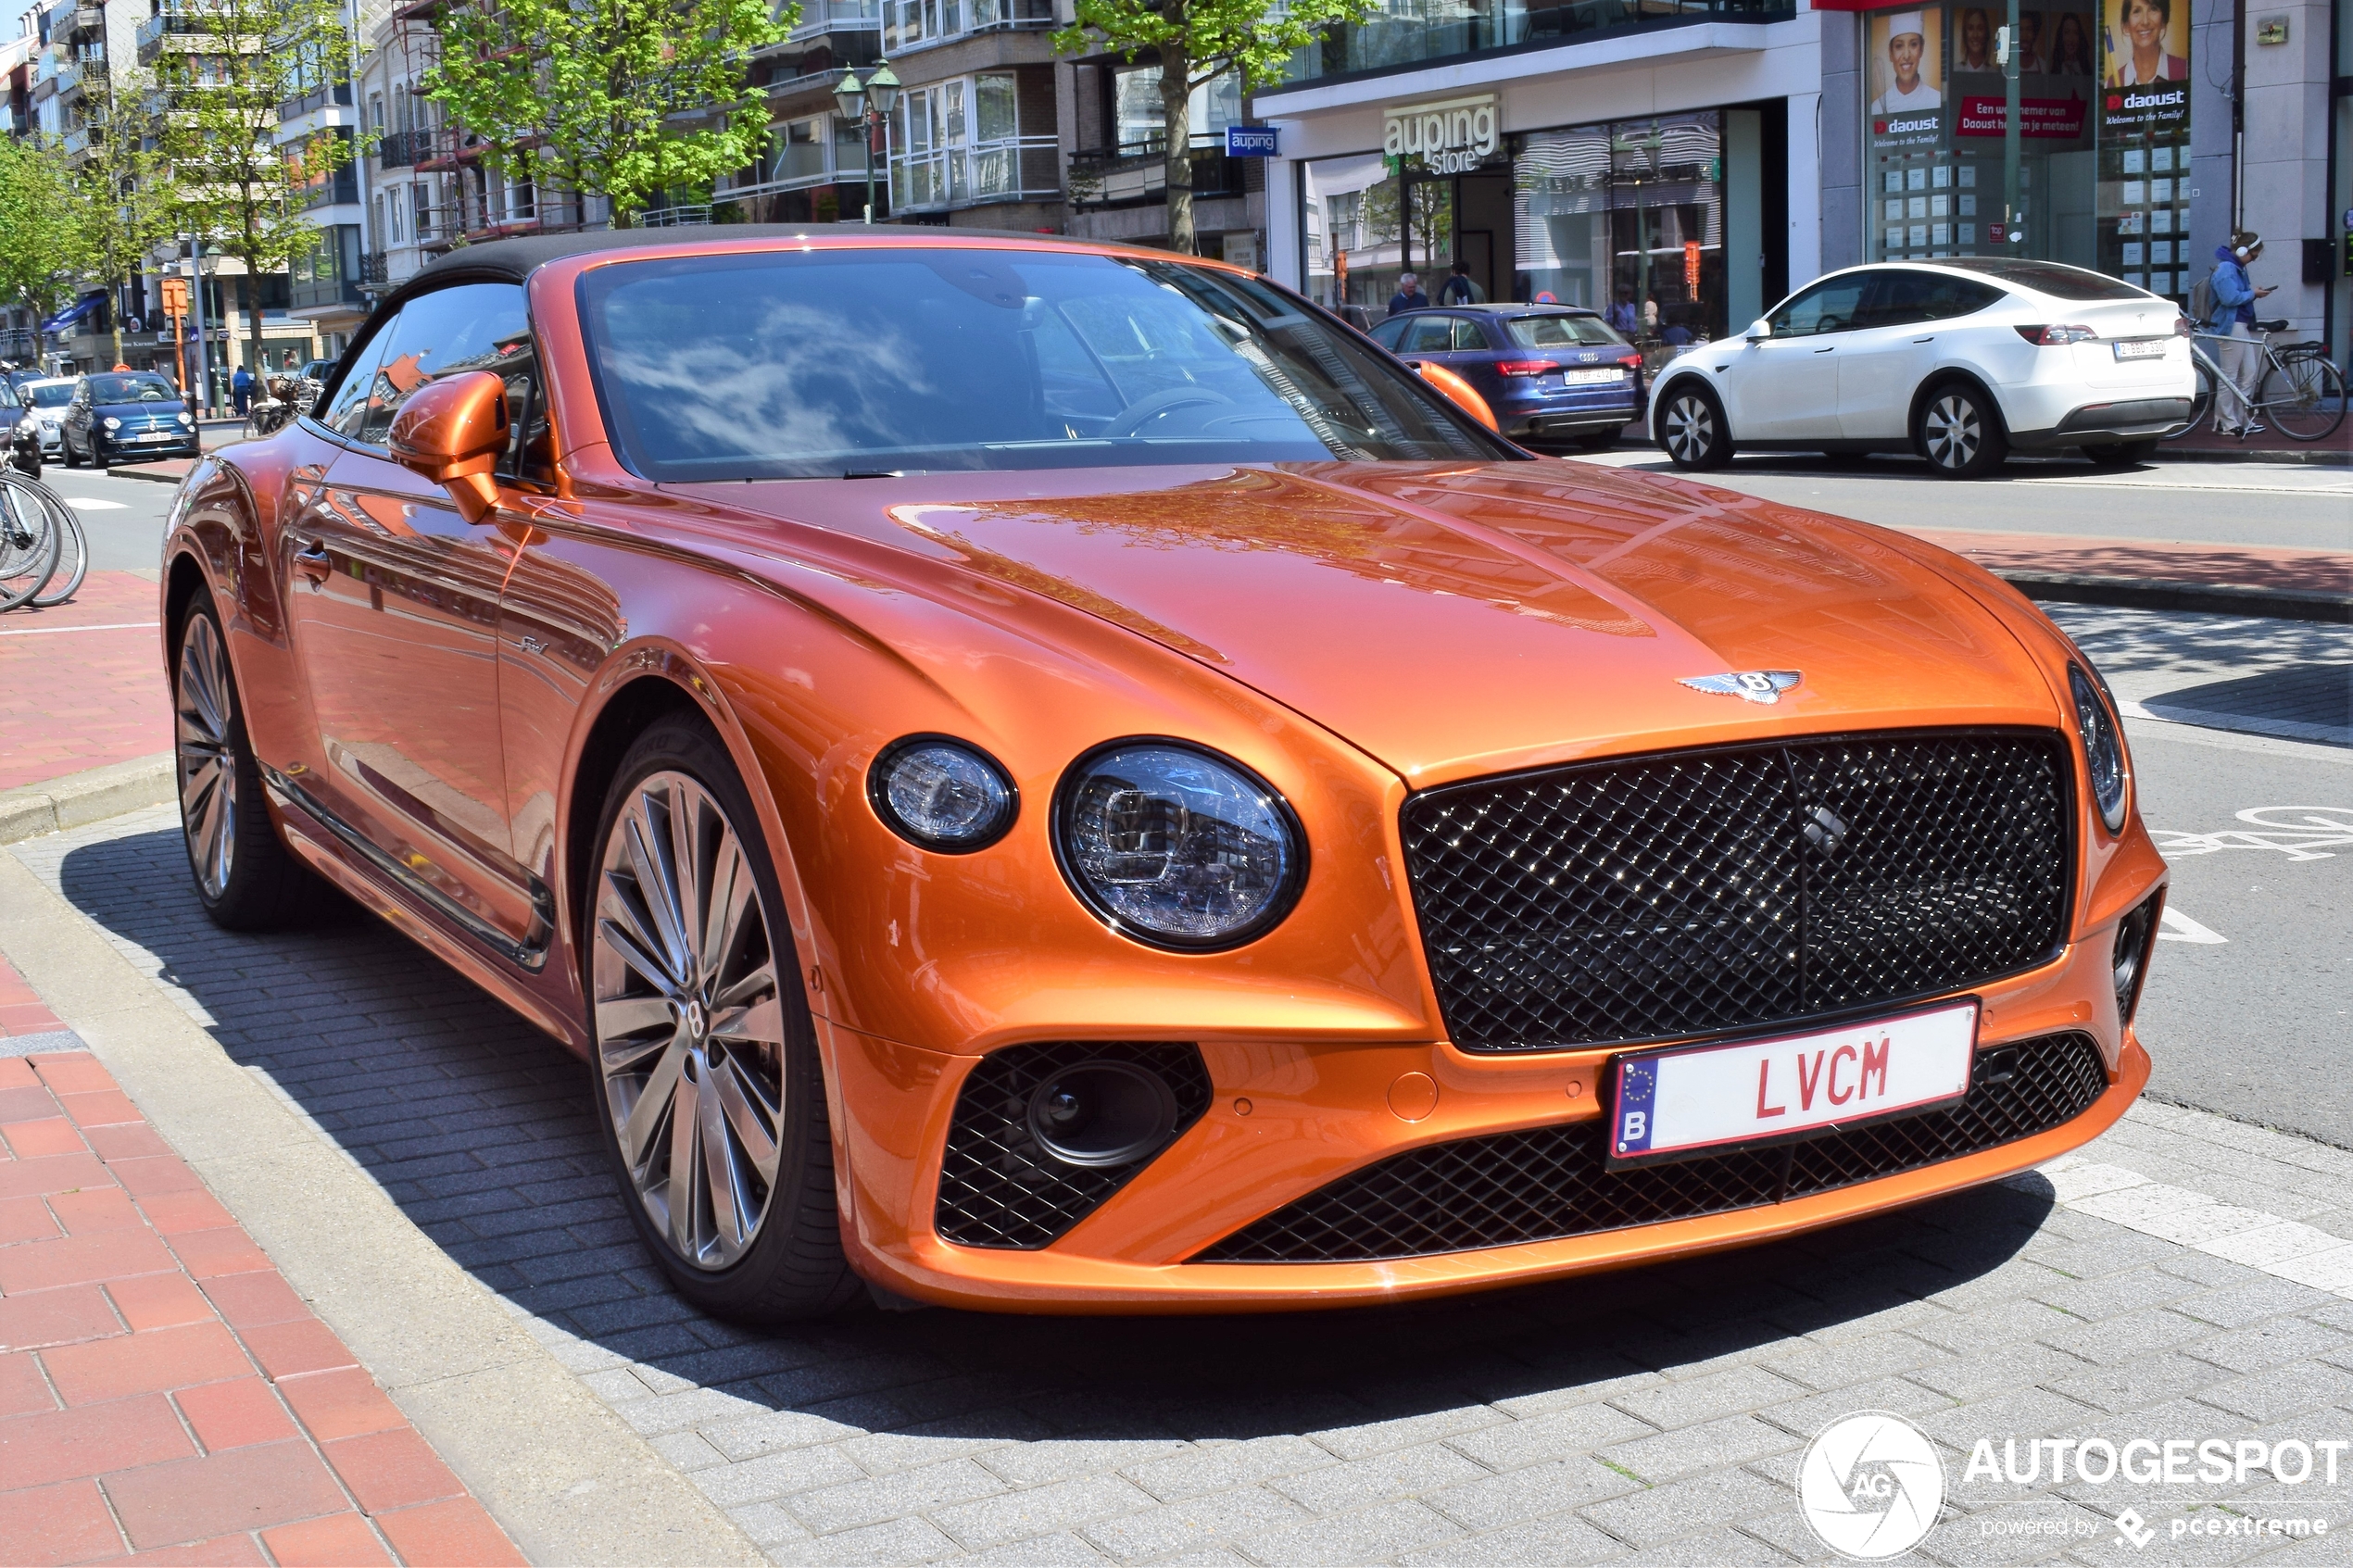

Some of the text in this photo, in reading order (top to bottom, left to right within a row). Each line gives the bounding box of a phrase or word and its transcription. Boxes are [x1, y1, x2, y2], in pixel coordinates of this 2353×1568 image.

[2123, 90, 2184, 109] daoust
[1976, 103, 1994, 114] Een
[2048, 107, 2066, 116] van
[2106, 116, 2135, 125] Welcome
[2145, 112, 2157, 121] the
[2158, 109, 2184, 121] Family!
[1888, 117, 1939, 133] daoust
[1963, 118, 1996, 129] Daoust
[2031, 119, 2040, 132] je
[2042, 120, 2079, 132] meteen!
[1383, 105, 1495, 164] auping
[1873, 139, 1898, 147] Welcome
[1916, 134, 1939, 144] Family!
[1232, 136, 1274, 150] auping
[1431, 149, 1476, 175] store
[1756, 1037, 1891, 1120] LVCM
[1623, 1111, 1646, 1141] B
